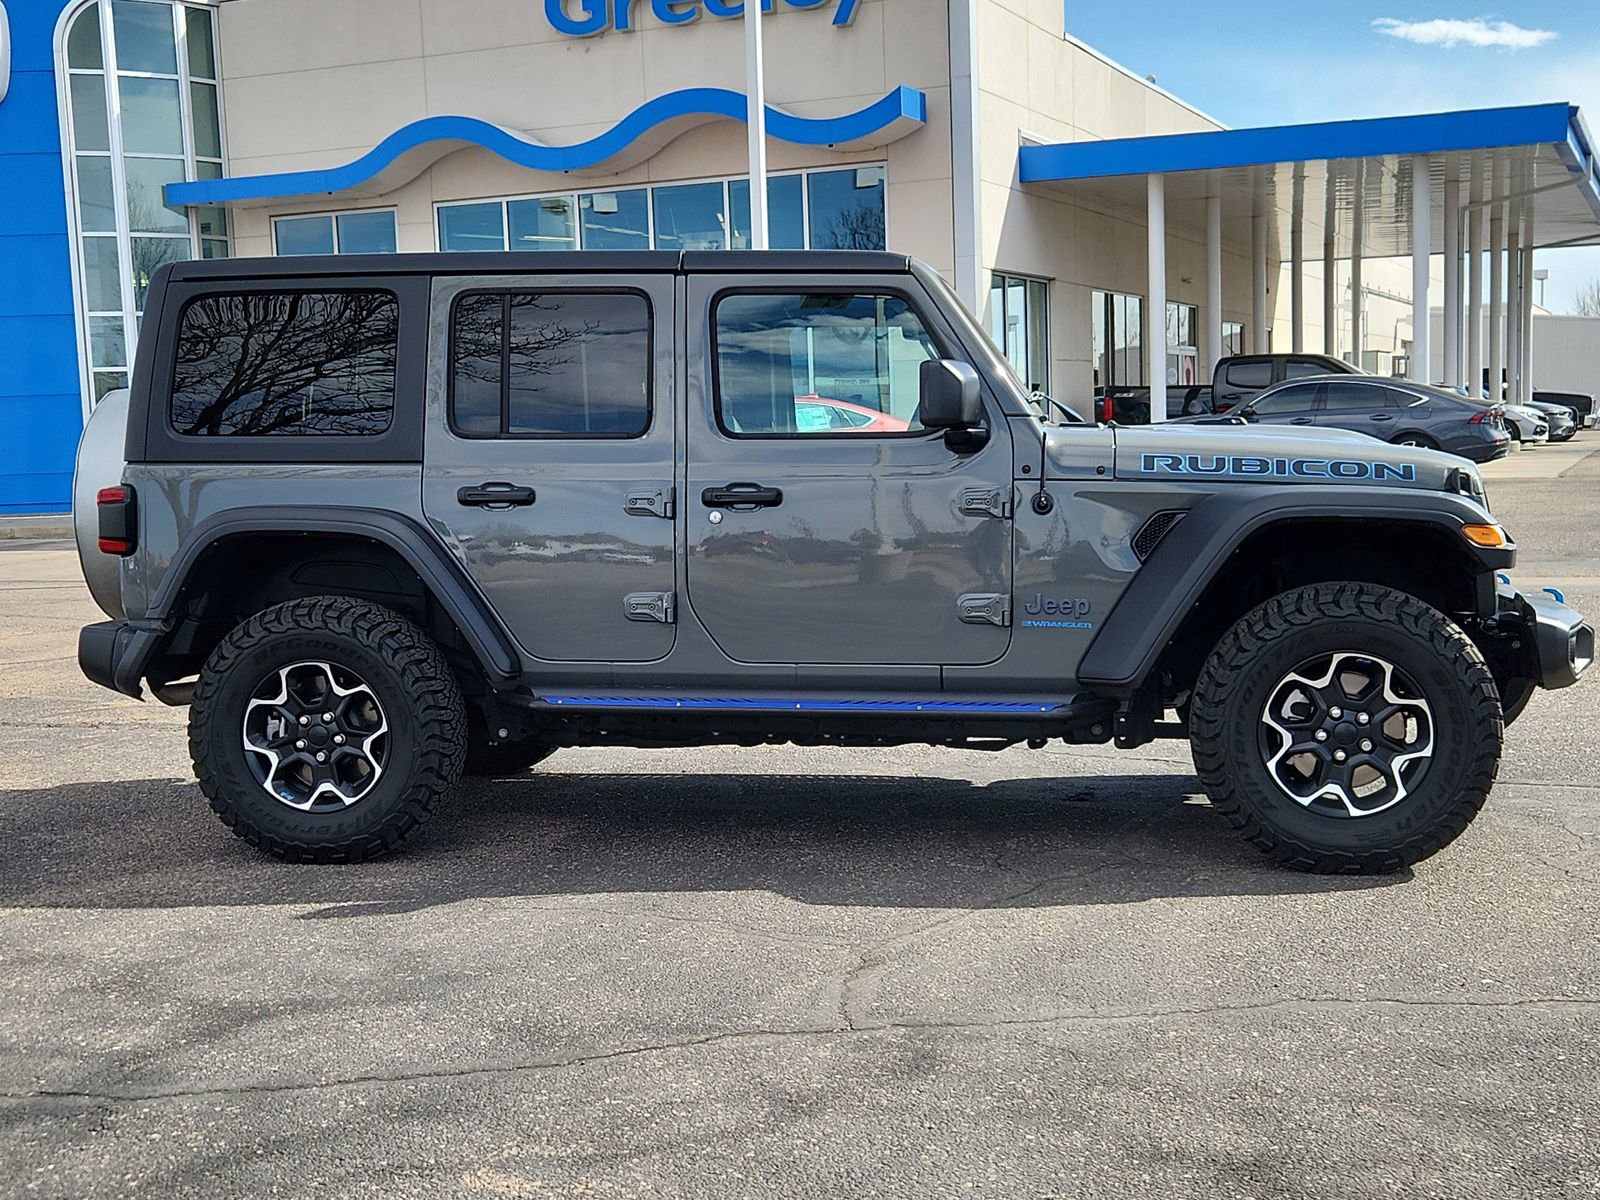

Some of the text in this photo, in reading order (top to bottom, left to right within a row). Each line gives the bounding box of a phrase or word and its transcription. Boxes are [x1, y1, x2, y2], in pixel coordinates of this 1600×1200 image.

[544, 0, 861, 37] Grey
[1140, 453, 1417, 482] RUBICON
[1024, 592, 1091, 619] Jeep
